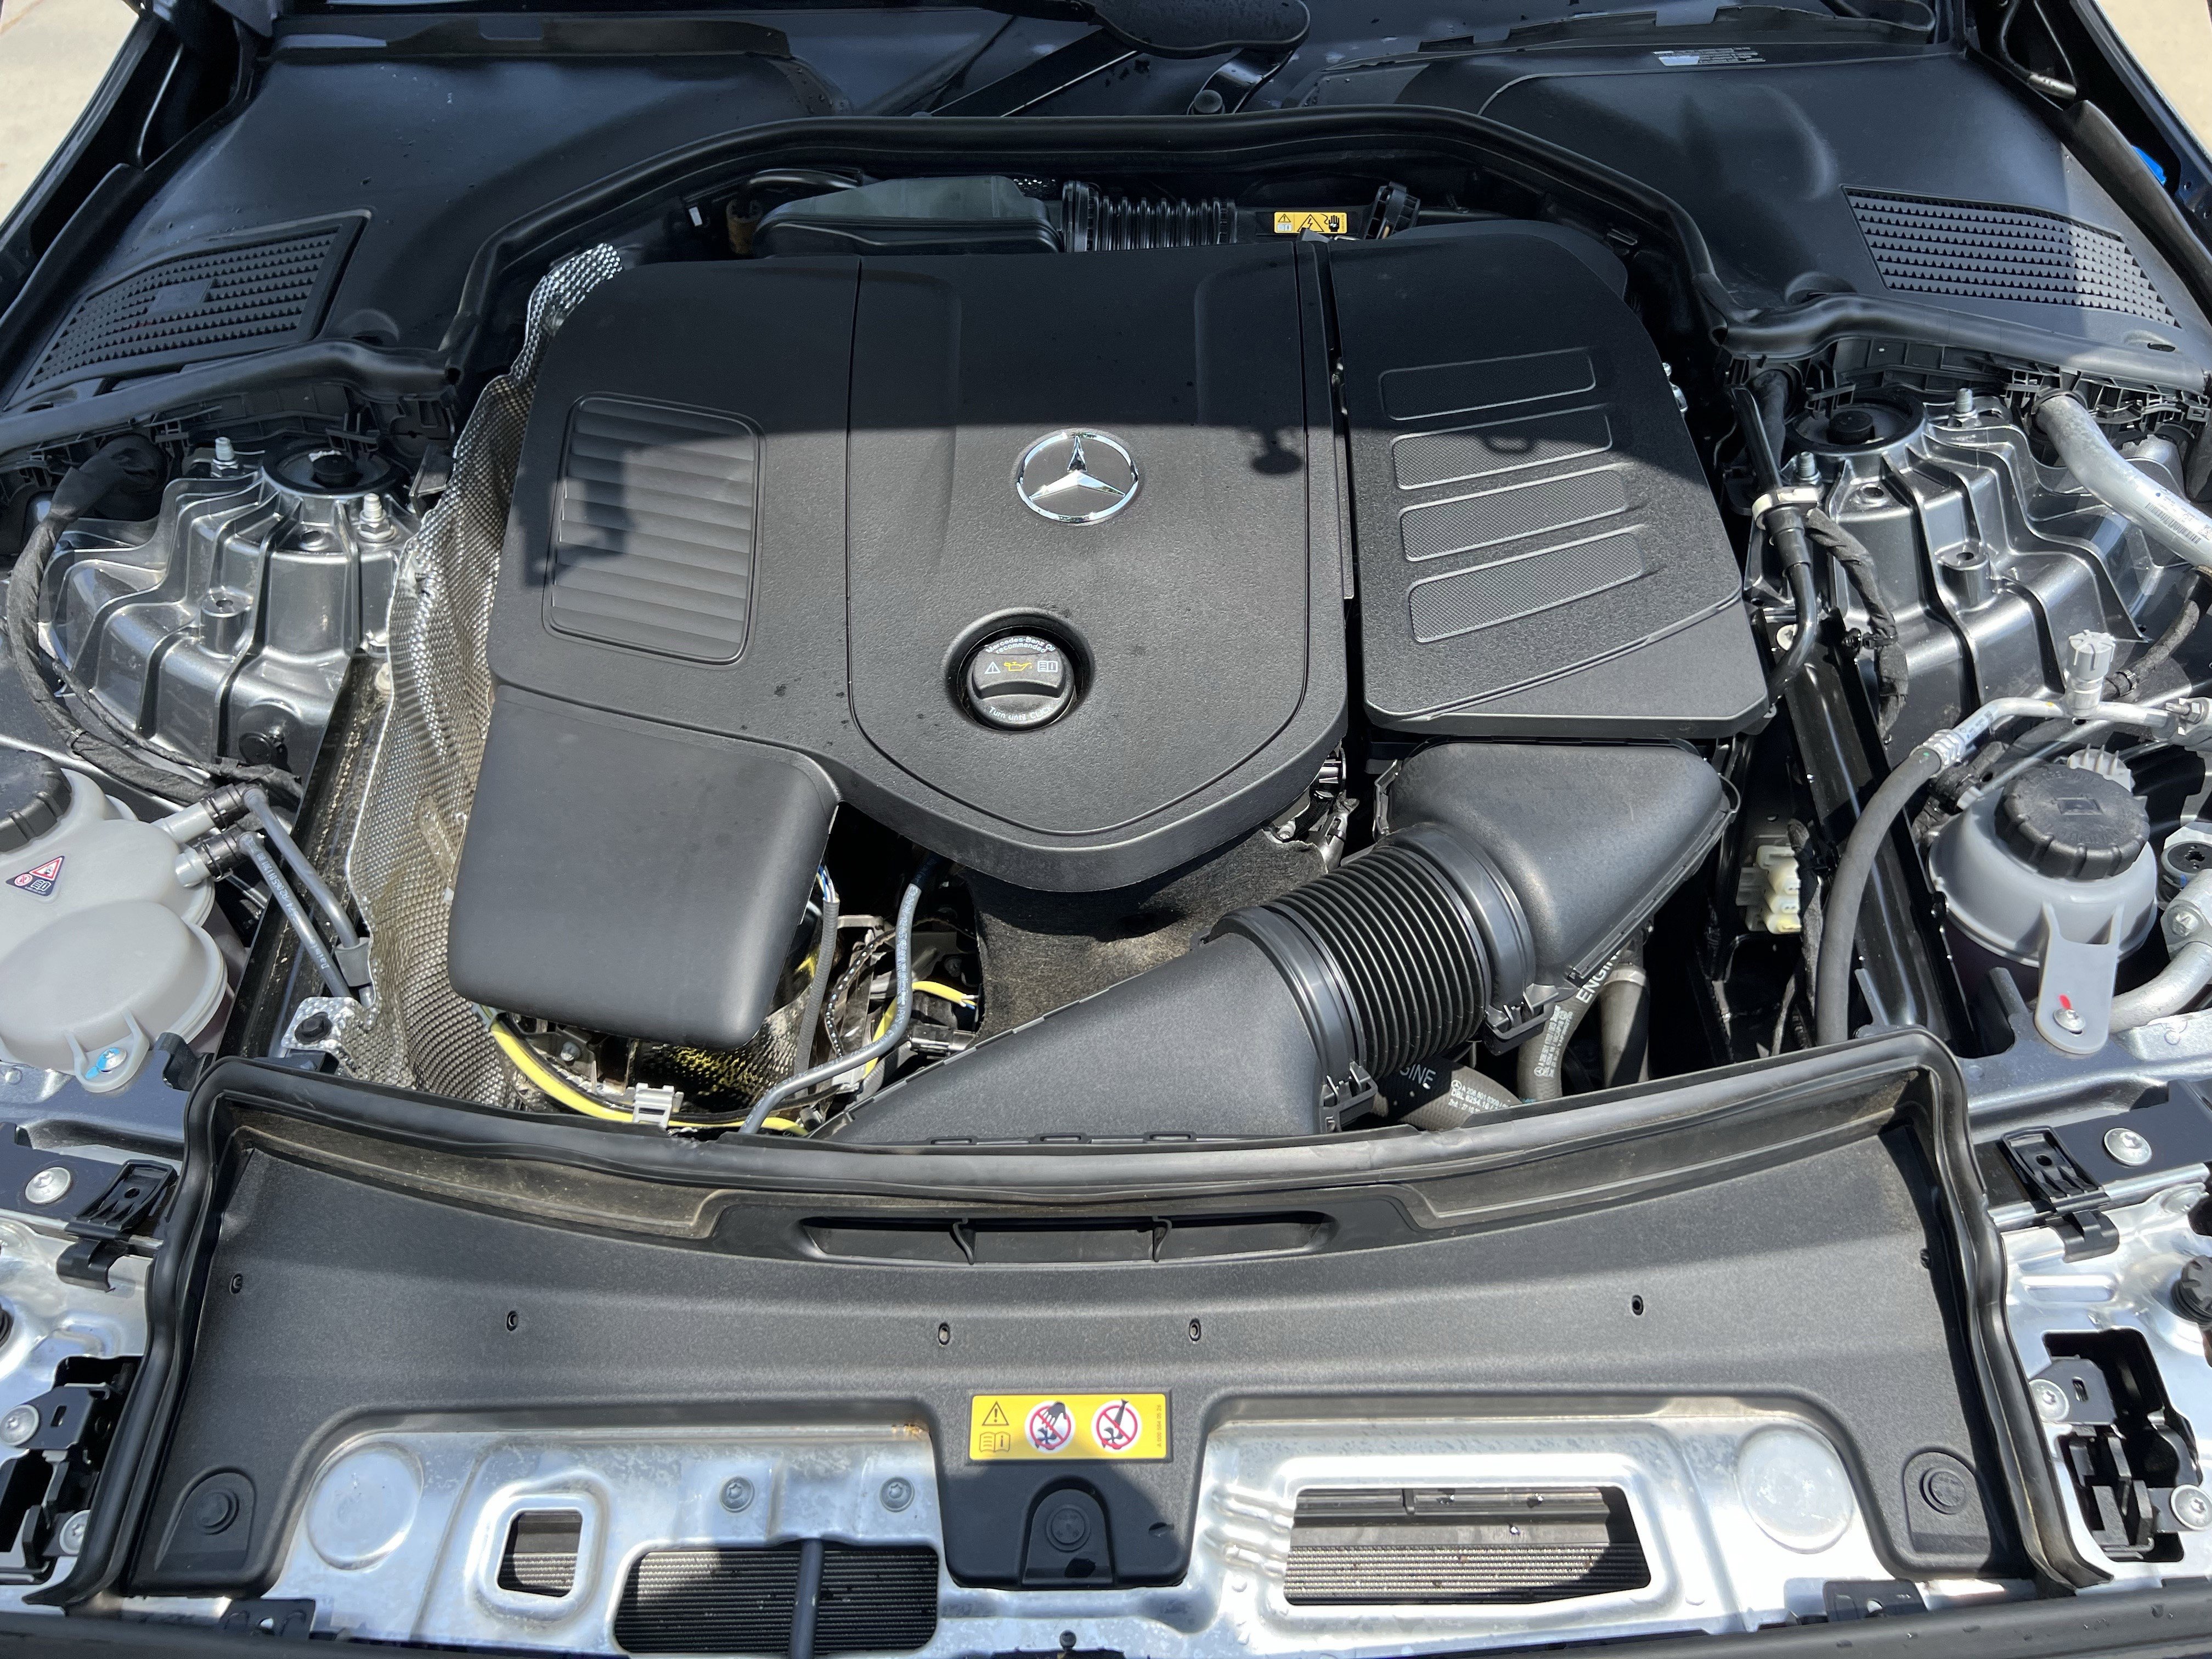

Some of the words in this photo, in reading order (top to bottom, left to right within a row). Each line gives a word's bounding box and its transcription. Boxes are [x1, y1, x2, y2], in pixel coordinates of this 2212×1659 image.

[985, 636, 1045, 653] Mercedes-Benz
[1045, 643, 1056, 652] Oil
[995, 642, 1045, 654] recommended
[989, 706, 1006, 719] Turn
[1008, 713, 1026, 721] until
[1029, 704, 1053, 719] CLICK
